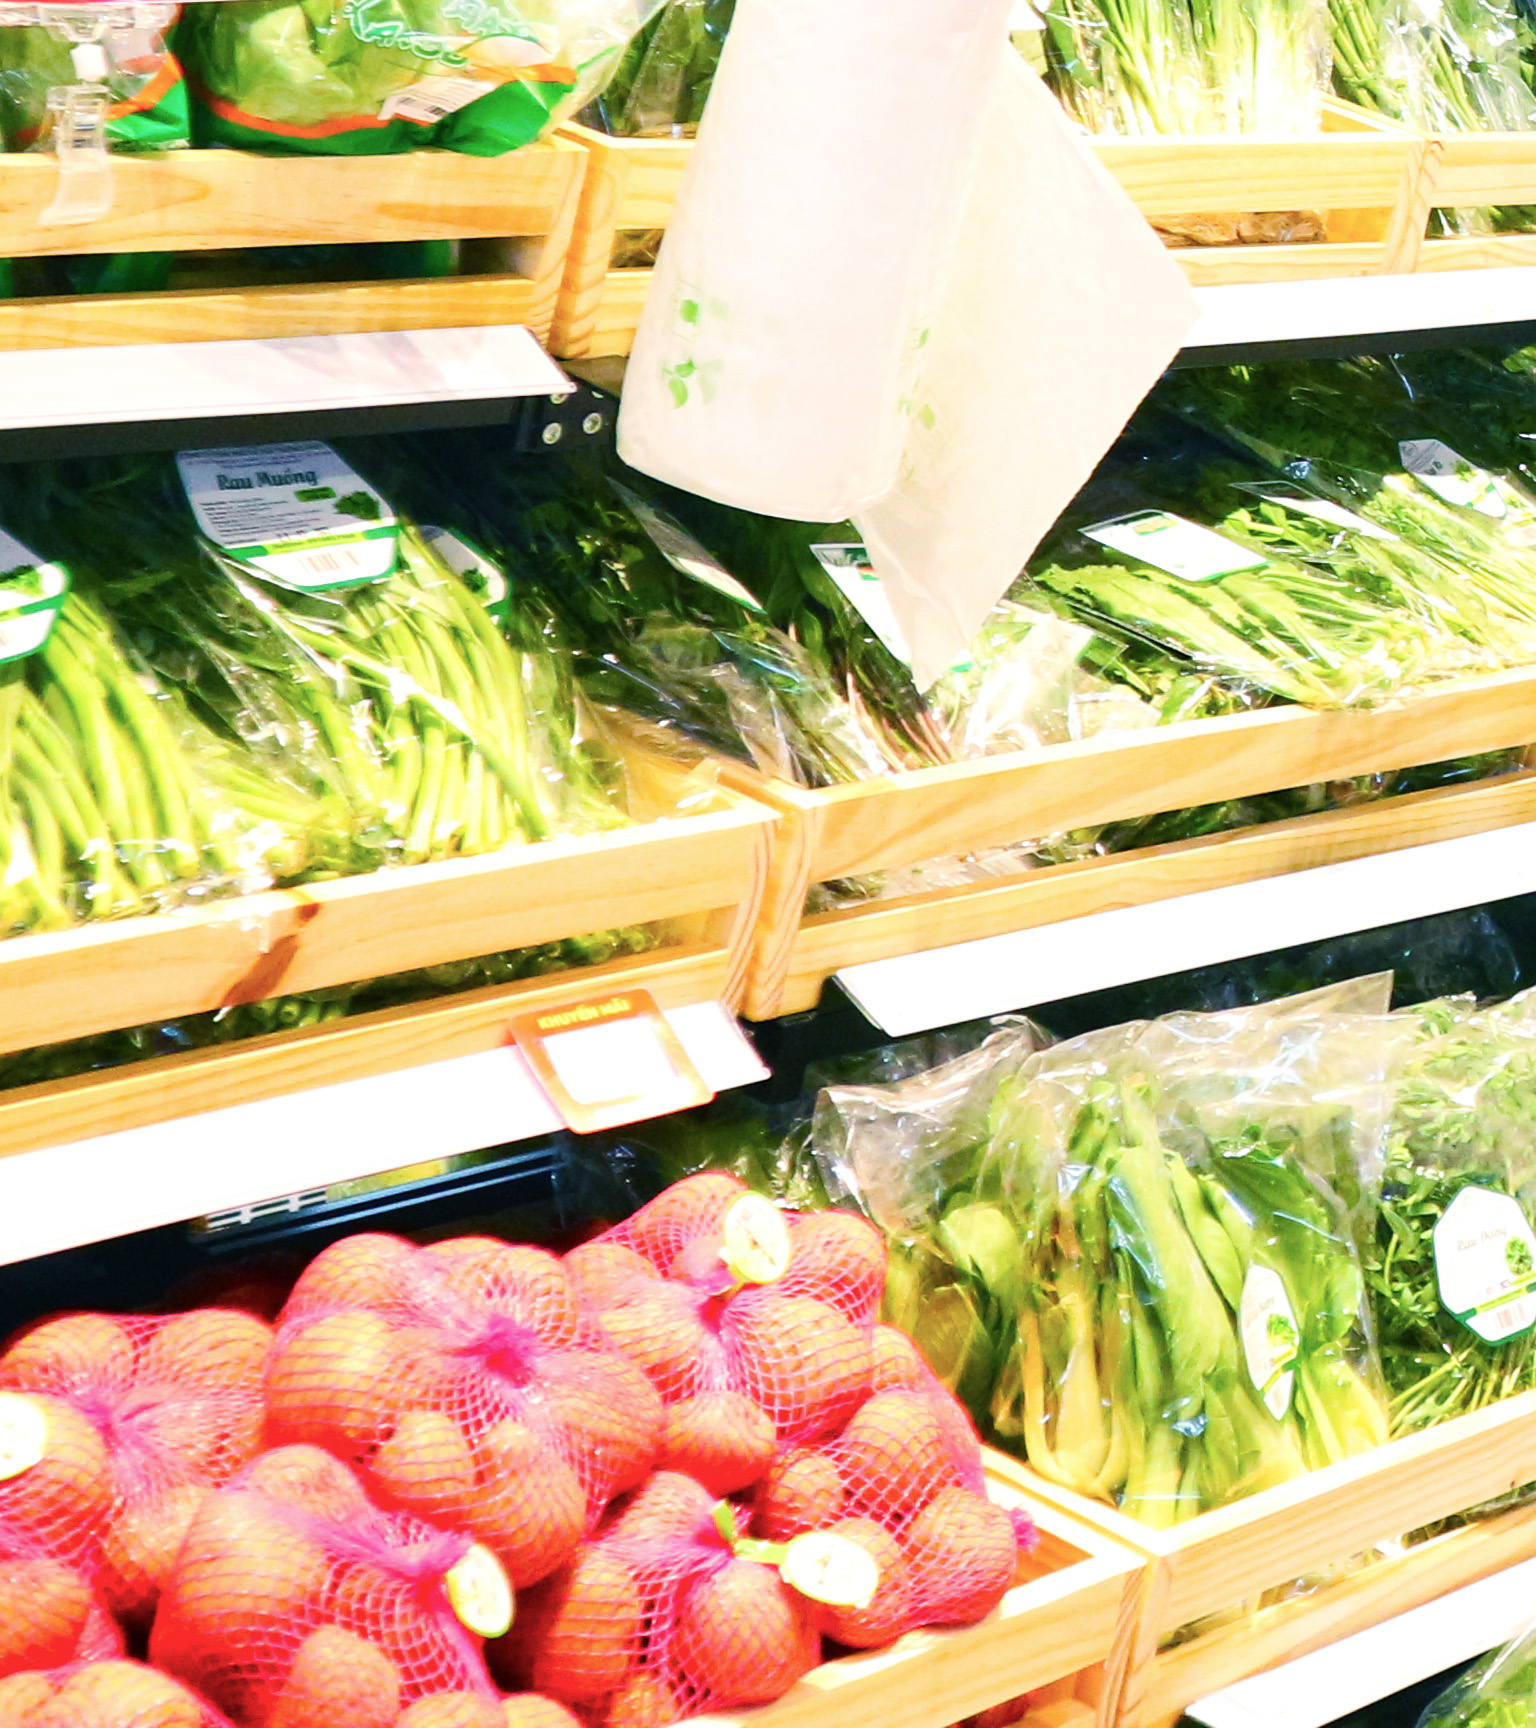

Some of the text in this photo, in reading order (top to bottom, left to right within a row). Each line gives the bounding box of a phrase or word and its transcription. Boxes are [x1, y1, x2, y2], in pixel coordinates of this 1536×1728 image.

[216, 467, 319, 491] Rau Muống
[537, 996, 631, 1030] KHUYẾN MÃI
